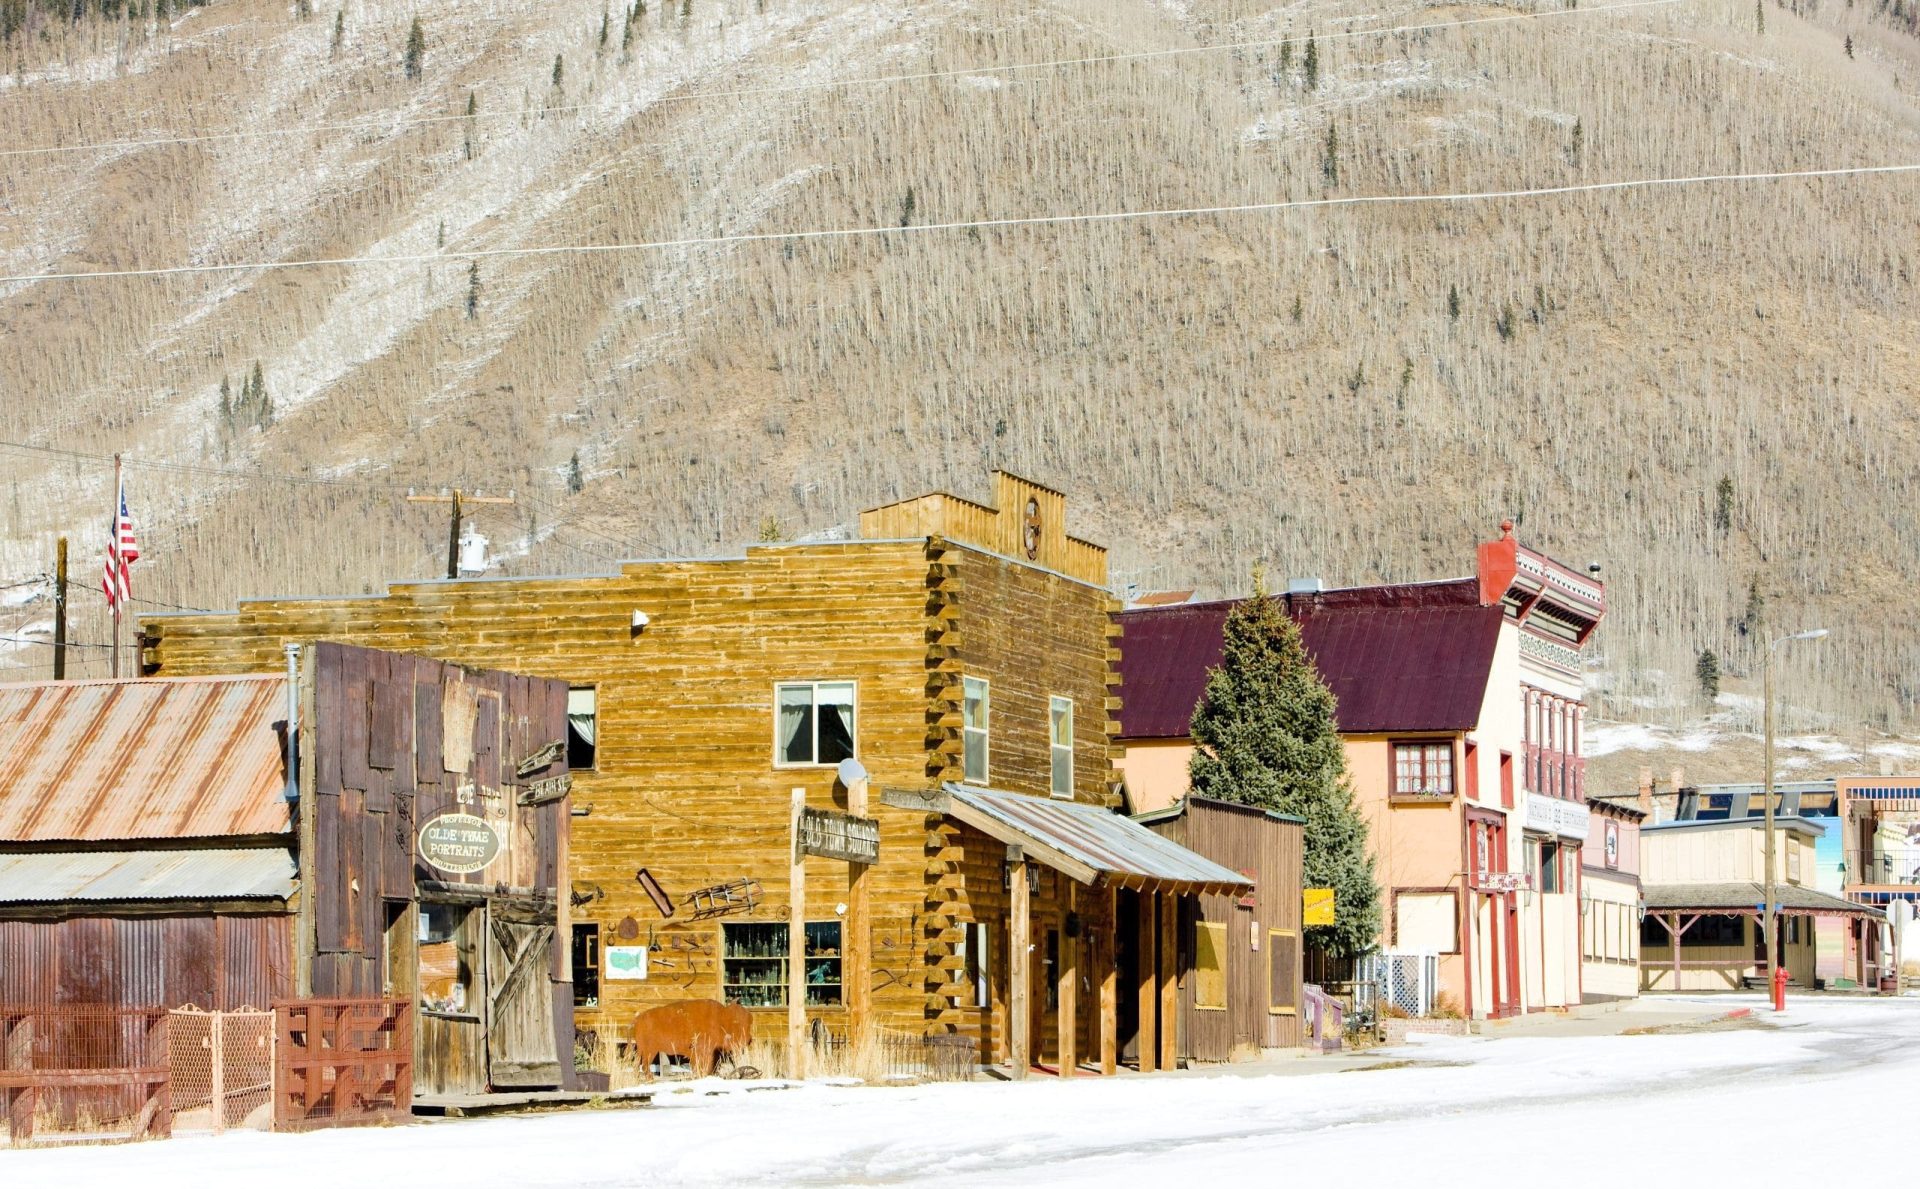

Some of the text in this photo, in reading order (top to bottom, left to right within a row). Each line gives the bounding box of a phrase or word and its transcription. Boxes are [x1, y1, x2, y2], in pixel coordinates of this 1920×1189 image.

[428, 828, 457, 841] OLDE
[806, 815, 876, 857] OLD TOWN SQUARE
[430, 843, 485, 857] PORTRAITS
